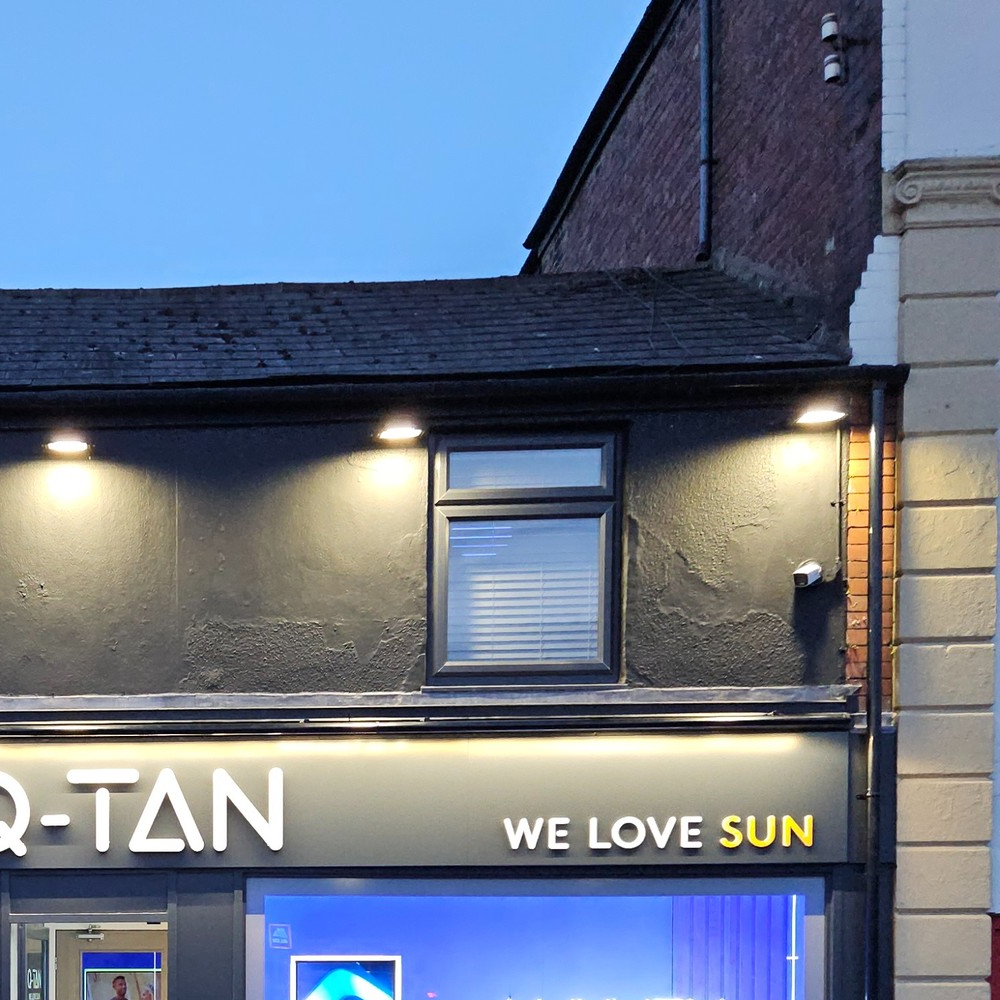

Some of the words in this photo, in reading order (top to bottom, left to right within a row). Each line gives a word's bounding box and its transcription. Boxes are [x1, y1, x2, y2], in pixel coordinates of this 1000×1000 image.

[503, 816, 571, 850] WE
[588, 815, 703, 850] LOVE
[719, 814, 814, 849] SUN
